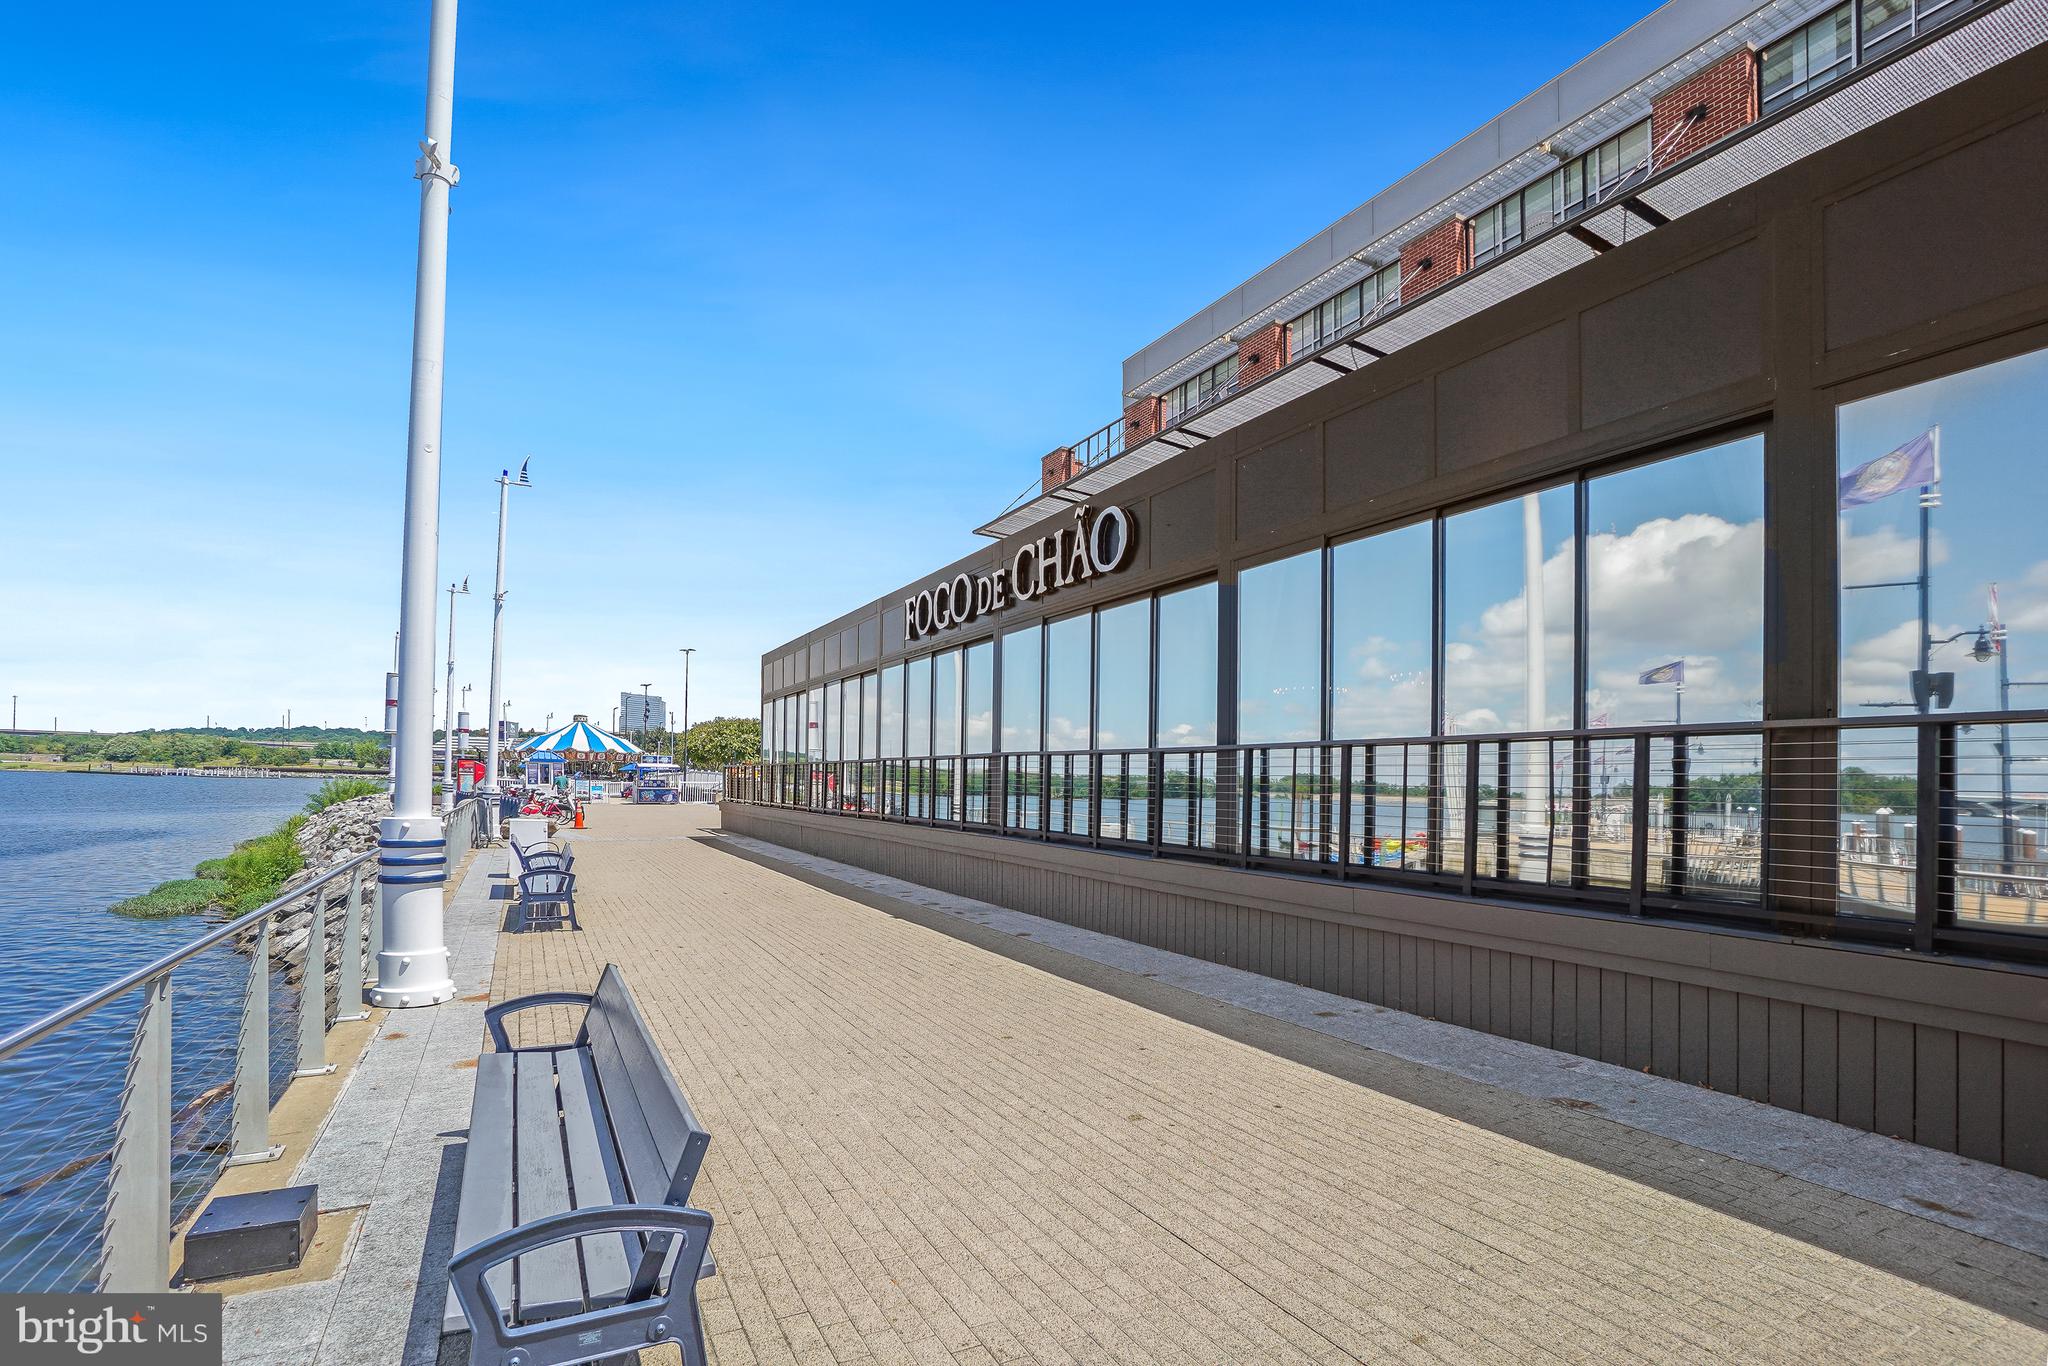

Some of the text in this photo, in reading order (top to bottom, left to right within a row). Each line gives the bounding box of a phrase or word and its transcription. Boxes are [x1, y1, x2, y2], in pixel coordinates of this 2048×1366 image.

[905, 504, 1128, 641] FOGO DE CHÃO
